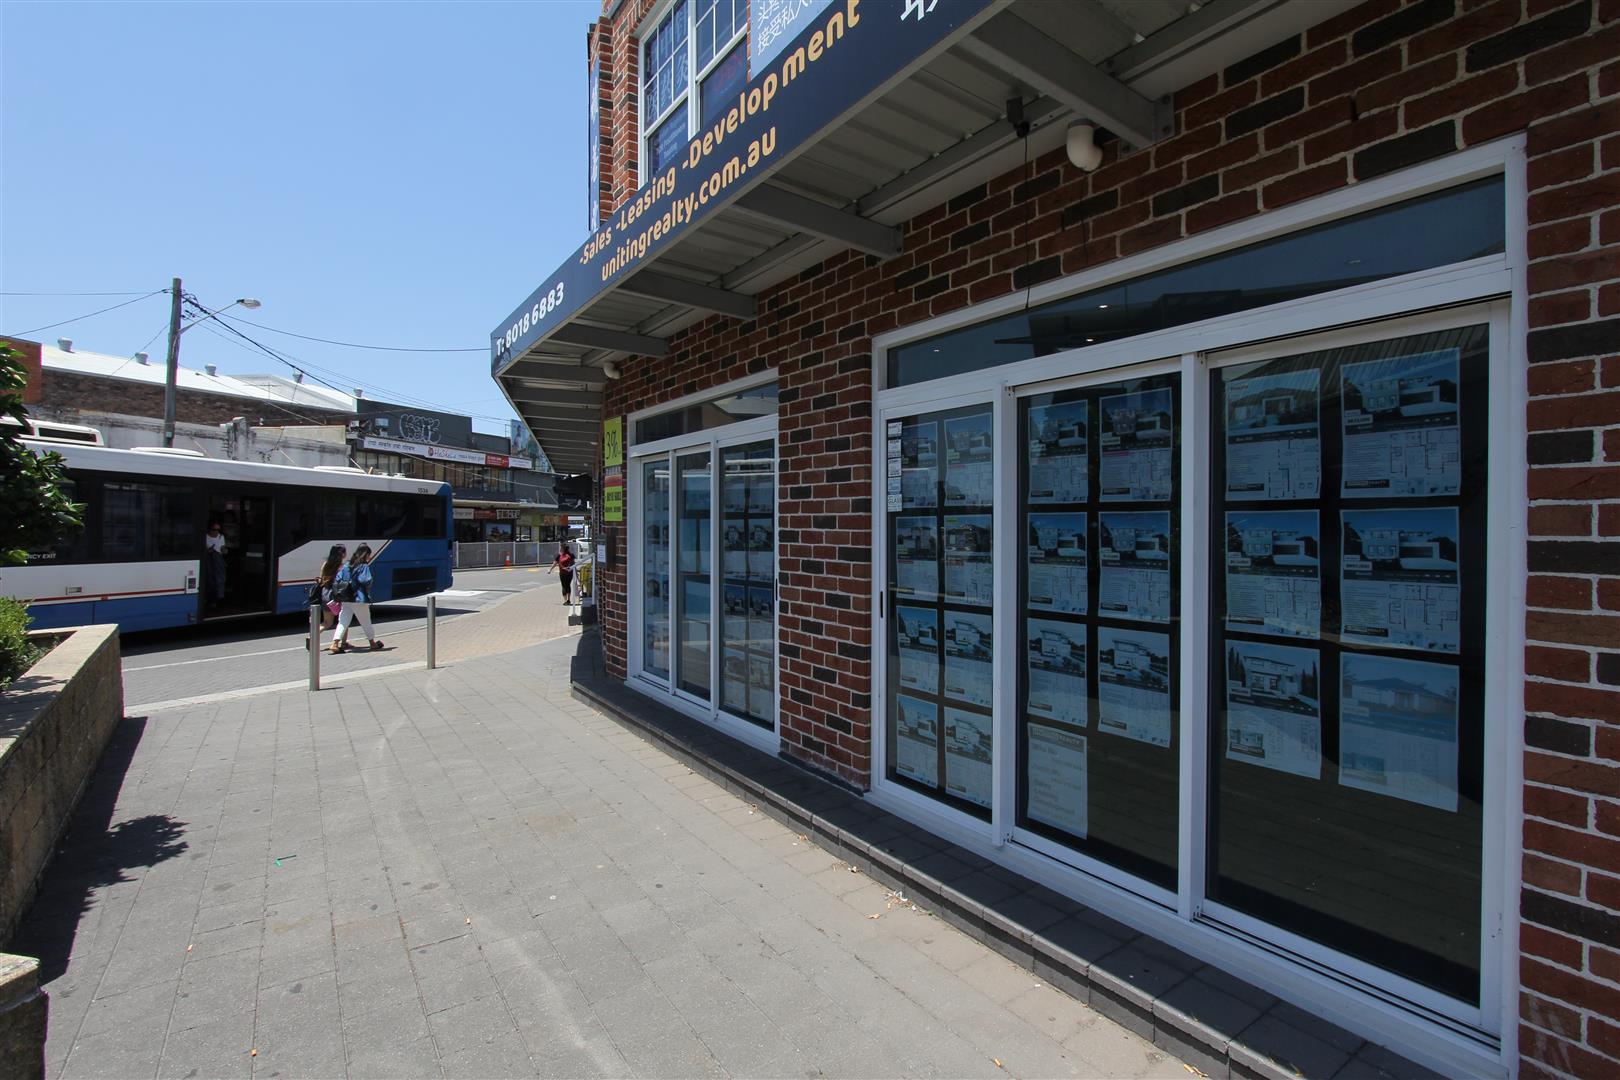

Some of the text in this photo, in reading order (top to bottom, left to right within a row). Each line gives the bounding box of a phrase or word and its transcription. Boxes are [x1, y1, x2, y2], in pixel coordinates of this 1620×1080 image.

[602, 126, 776, 281] unitingrealty.com.au
[505, 312, 530, 348] 8018
[531, 281, 564, 325] 6883
